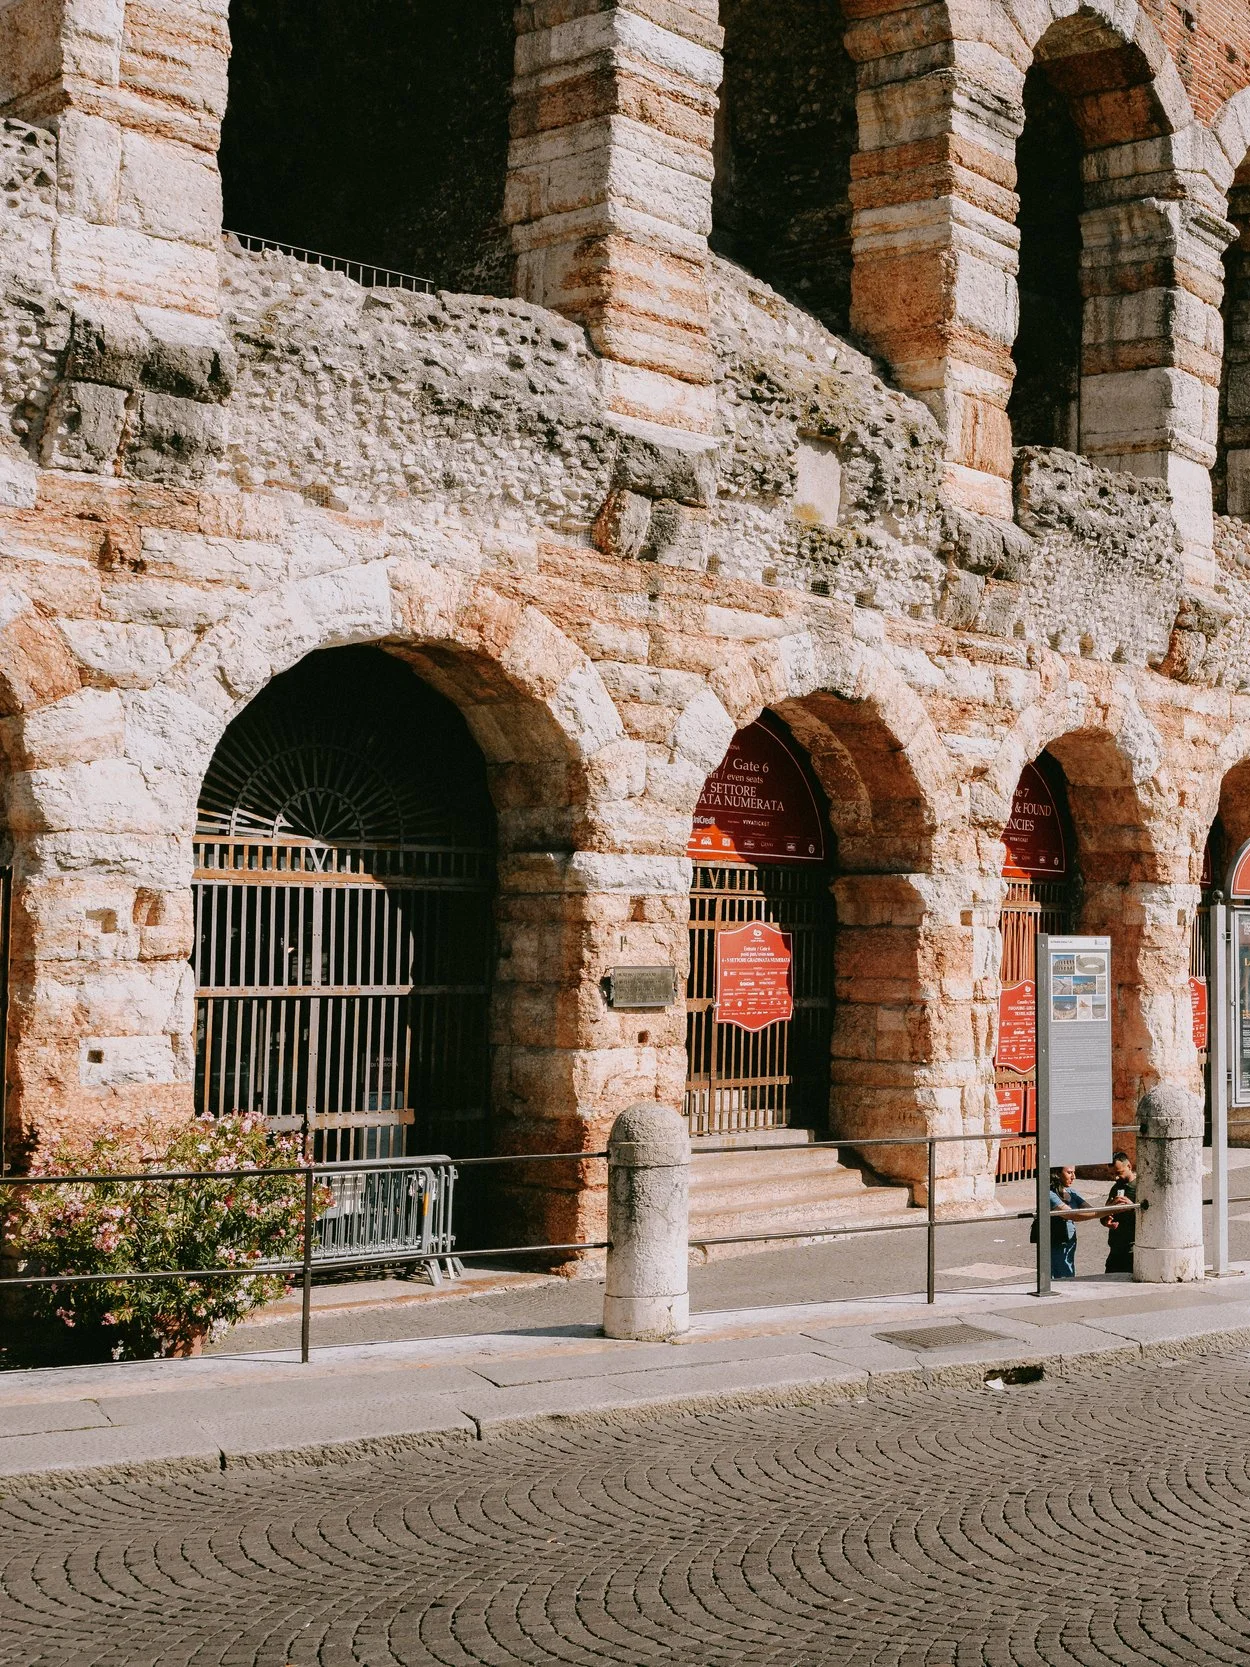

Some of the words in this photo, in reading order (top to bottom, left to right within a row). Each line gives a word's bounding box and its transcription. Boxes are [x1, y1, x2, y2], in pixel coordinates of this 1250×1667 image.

[733, 758, 760, 772] Gate
[762, 762, 769, 773] 6
[727, 774, 744, 782] even
[746, 776, 764, 784] seats
[710, 782, 756, 797] SETTORE
[1024, 788, 1029, 797] 7
[699, 794, 722, 805] ATA
[724, 796, 784, 811] NUMERATA
[1014, 802, 1021, 813] &
[1022, 802, 1051, 816] FOUND
[743, 819, 770, 827] VIVATICKET
[1005, 818, 1034, 831] NCIES
